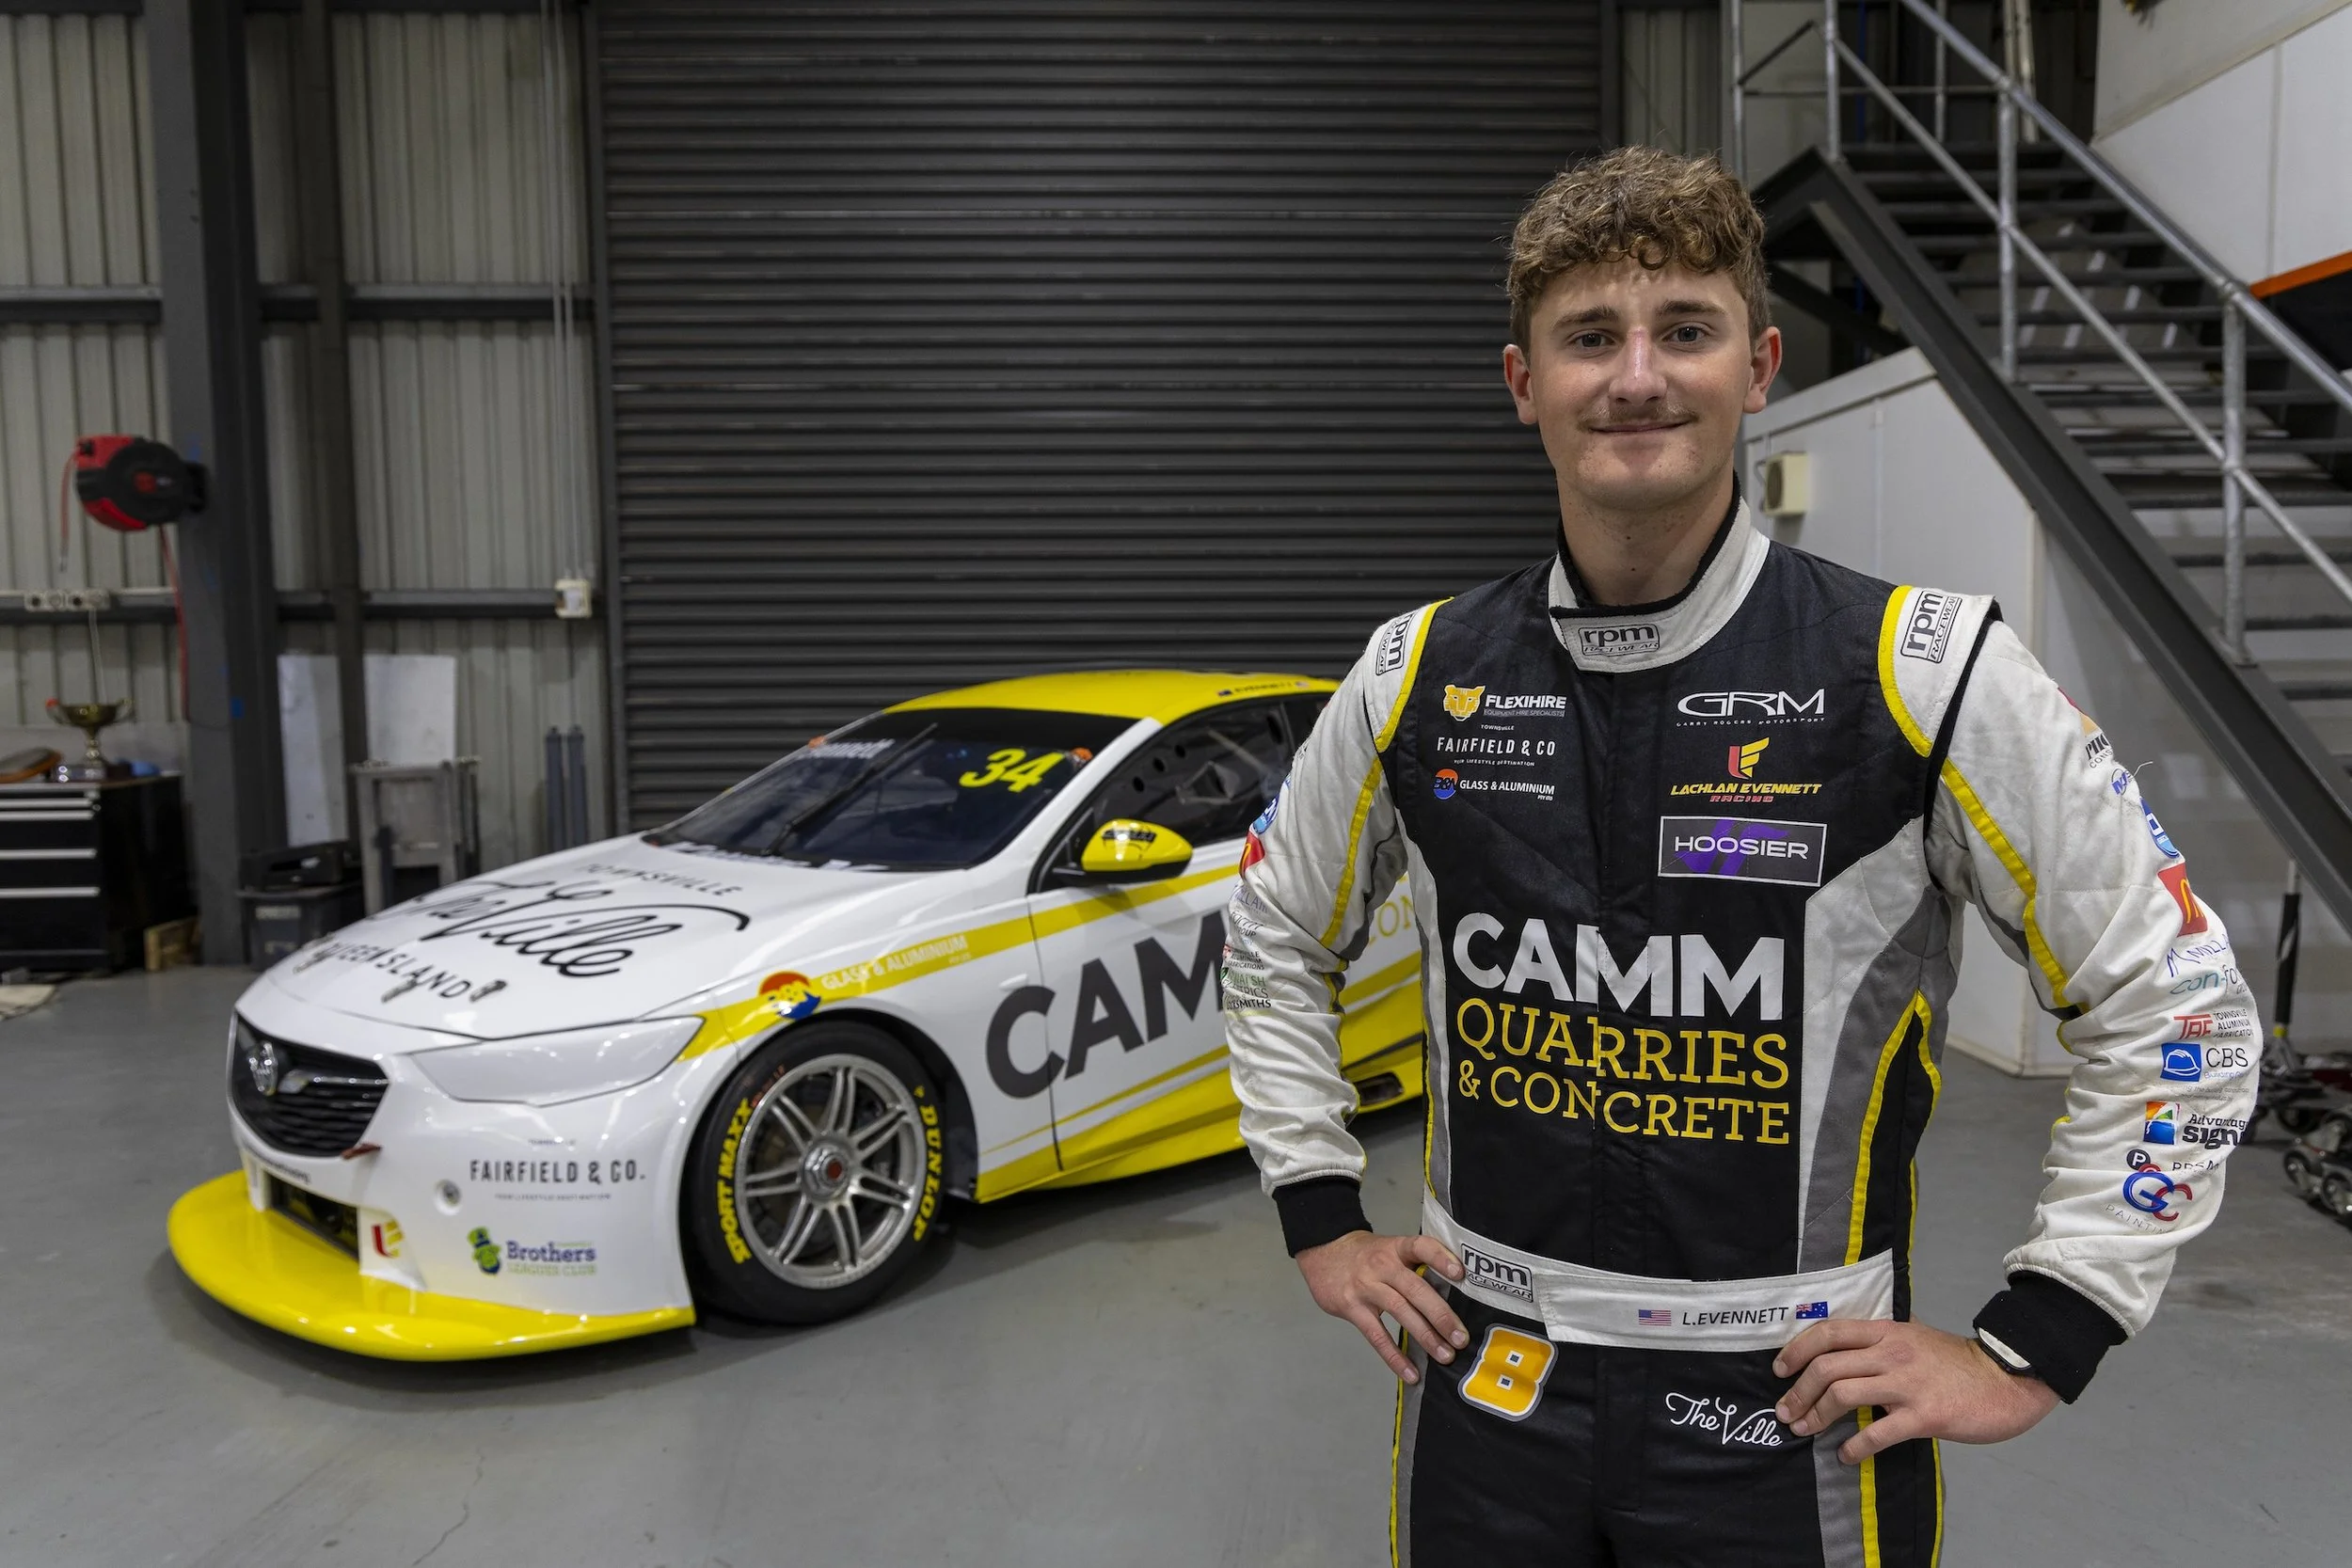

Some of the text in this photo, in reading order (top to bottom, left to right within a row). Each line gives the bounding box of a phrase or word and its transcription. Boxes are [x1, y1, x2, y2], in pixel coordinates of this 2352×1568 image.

[1907, 594, 1944, 651] rpm
[1931, 596, 1959, 659] RACEWEAR
[1583, 626, 1654, 647] rpm
[1485, 694, 1567, 708] FLEXIHIRE
[1677, 689, 1825, 717] GRM
[1758, 717, 1825, 725] MOTORSPORT
[1437, 736, 1556, 756] FAIRFIELD & CO
[960, 749, 1066, 792] 34
[1460, 780, 1488, 790] GLASS
[1490, 781, 1498, 791] &
[1499, 782, 1555, 795] ALUMINIUM
[1671, 783, 1822, 796] LACHLAN EVENNETT
[1675, 835, 1809, 860] HOOSIER
[886, 935, 969, 973] ALUMINIUM
[1453, 911, 1785, 1021] CAMM
[2213, 1008, 2247, 1022] TOWNSVILLE
[1457, 998, 1789, 1088] QUARRIES
[2206, 1048, 2249, 1068] CBS
[1458, 1059, 1789, 1145] & CONCRETE
[470, 1159, 646, 1185] FAIRFIELD & CO.
[717, 1098, 753, 1264] SPORT MAXX
[913, 1105, 942, 1242] DUNLOP
[506, 1241, 596, 1262] Brothers
[1464, 1248, 1529, 1287] rpm
[1467, 1272, 1533, 1299] ACEWEAR
[1682, 1307, 1788, 1326] L.EVENNETT
[1457, 1323, 1559, 1421] 8
[1665, 1392, 1783, 1447] The Ville
